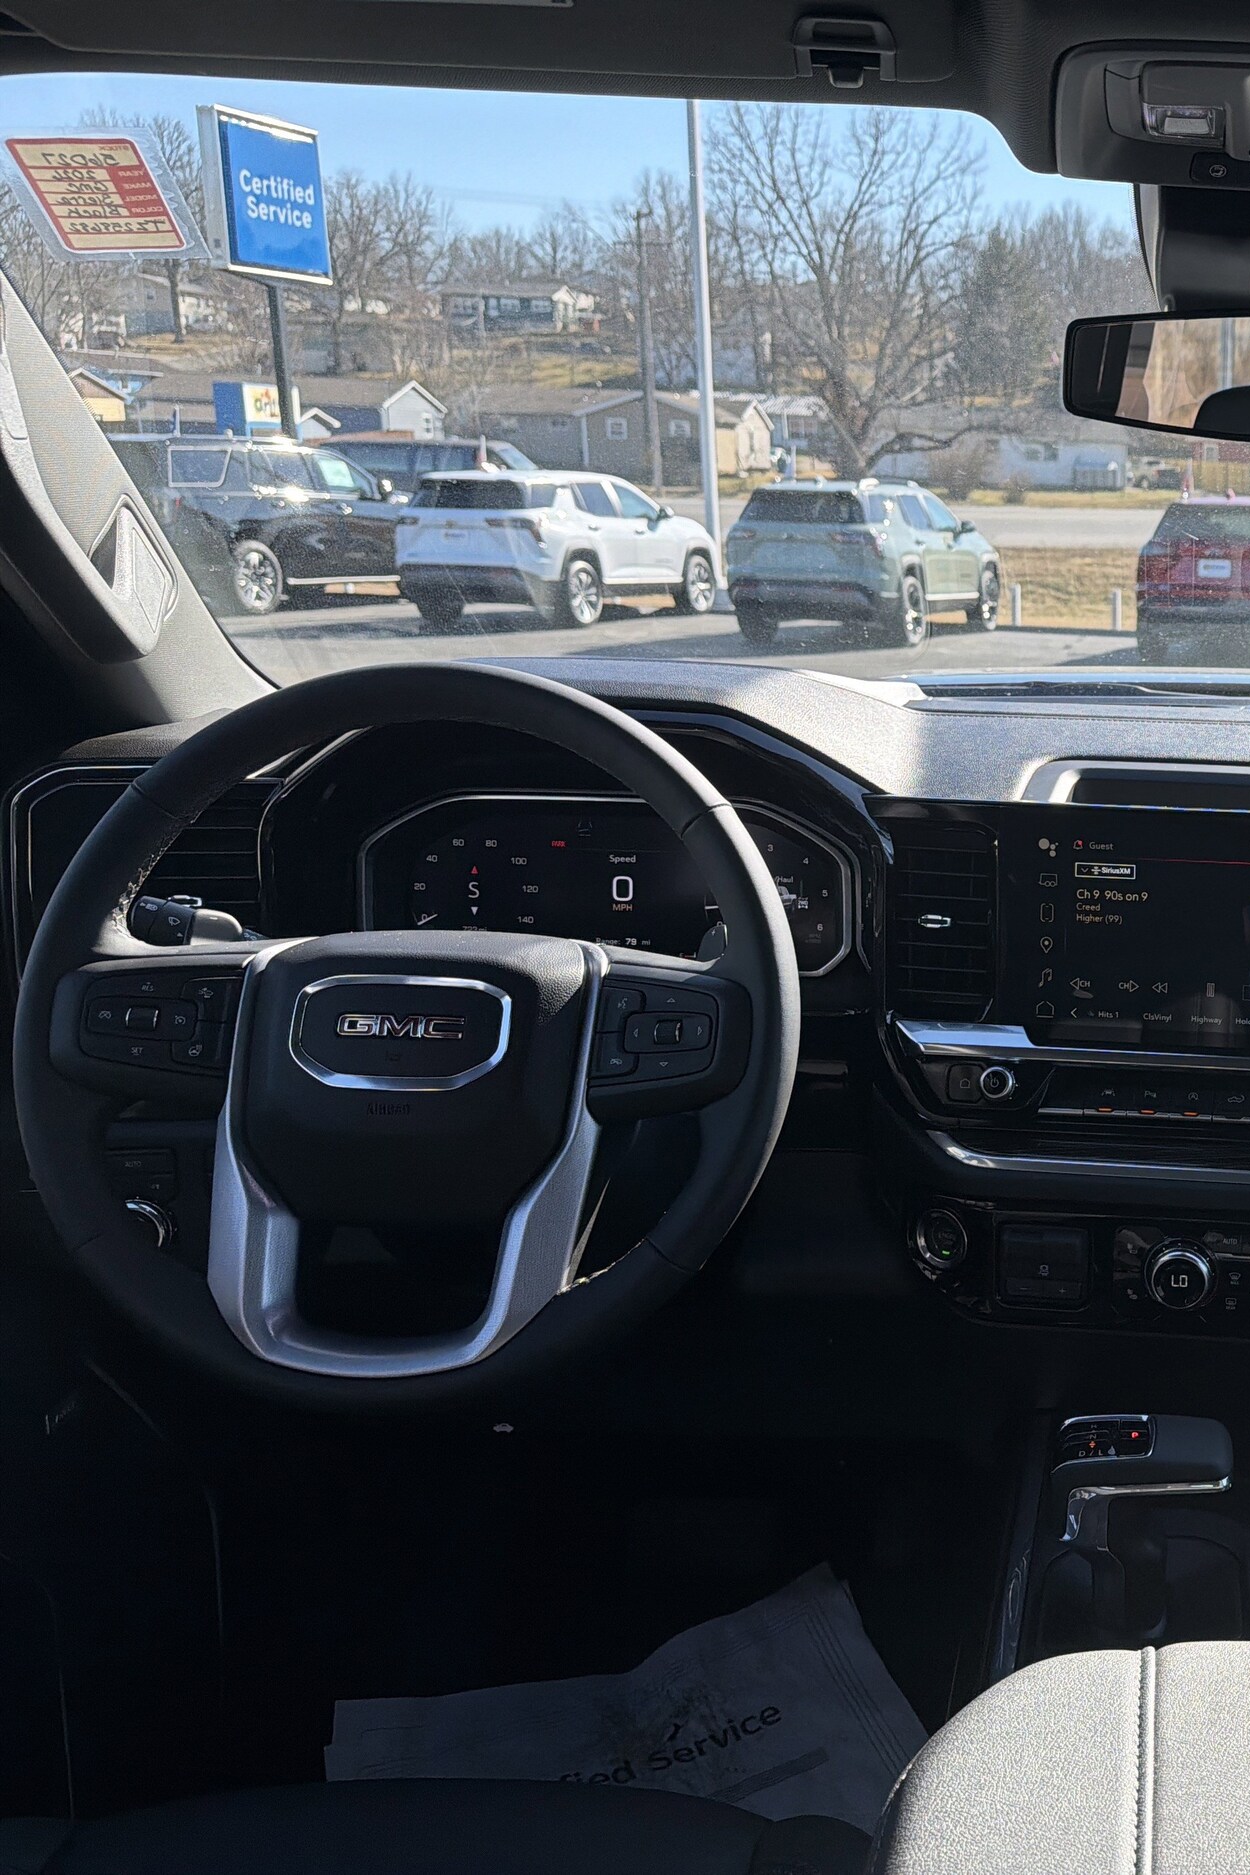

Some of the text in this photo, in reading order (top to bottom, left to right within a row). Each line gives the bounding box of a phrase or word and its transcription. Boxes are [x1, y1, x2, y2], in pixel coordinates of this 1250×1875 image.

[240, 168, 314, 206] Certified
[246, 195, 312, 229] Service
[452, 838, 465, 847] 60
[1089, 842, 1114, 850] Guest
[767, 844, 774, 852] 3
[426, 854, 438, 863] 40
[510, 857, 528, 865] 100
[609, 854, 637, 865] Speed
[1101, 866, 1131, 875] SiriusXM
[414, 882, 426, 891] 20
[468, 882, 480, 898] S
[522, 885, 539, 893] 120
[612, 876, 634, 902] 0
[1076, 889, 1149, 902] Ch 9 90s on 9
[1076, 903, 1101, 912] Creed
[516, 916, 534, 924] 140
[1076, 914, 1123, 925] Higher (99)
[1079, 980, 1091, 988] CH
[1118, 982, 1130, 991] CH
[1098, 1010, 1113, 1018] Hits
[1143, 1012, 1172, 1023] ClsVinyl
[1191, 1015, 1222, 1026] Highway
[336, 1013, 465, 1039] GMC
[1171, 1274, 1188, 1288] LO
[1131, 1431, 1139, 1439] P
[649, 1704, 782, 1771] Service
